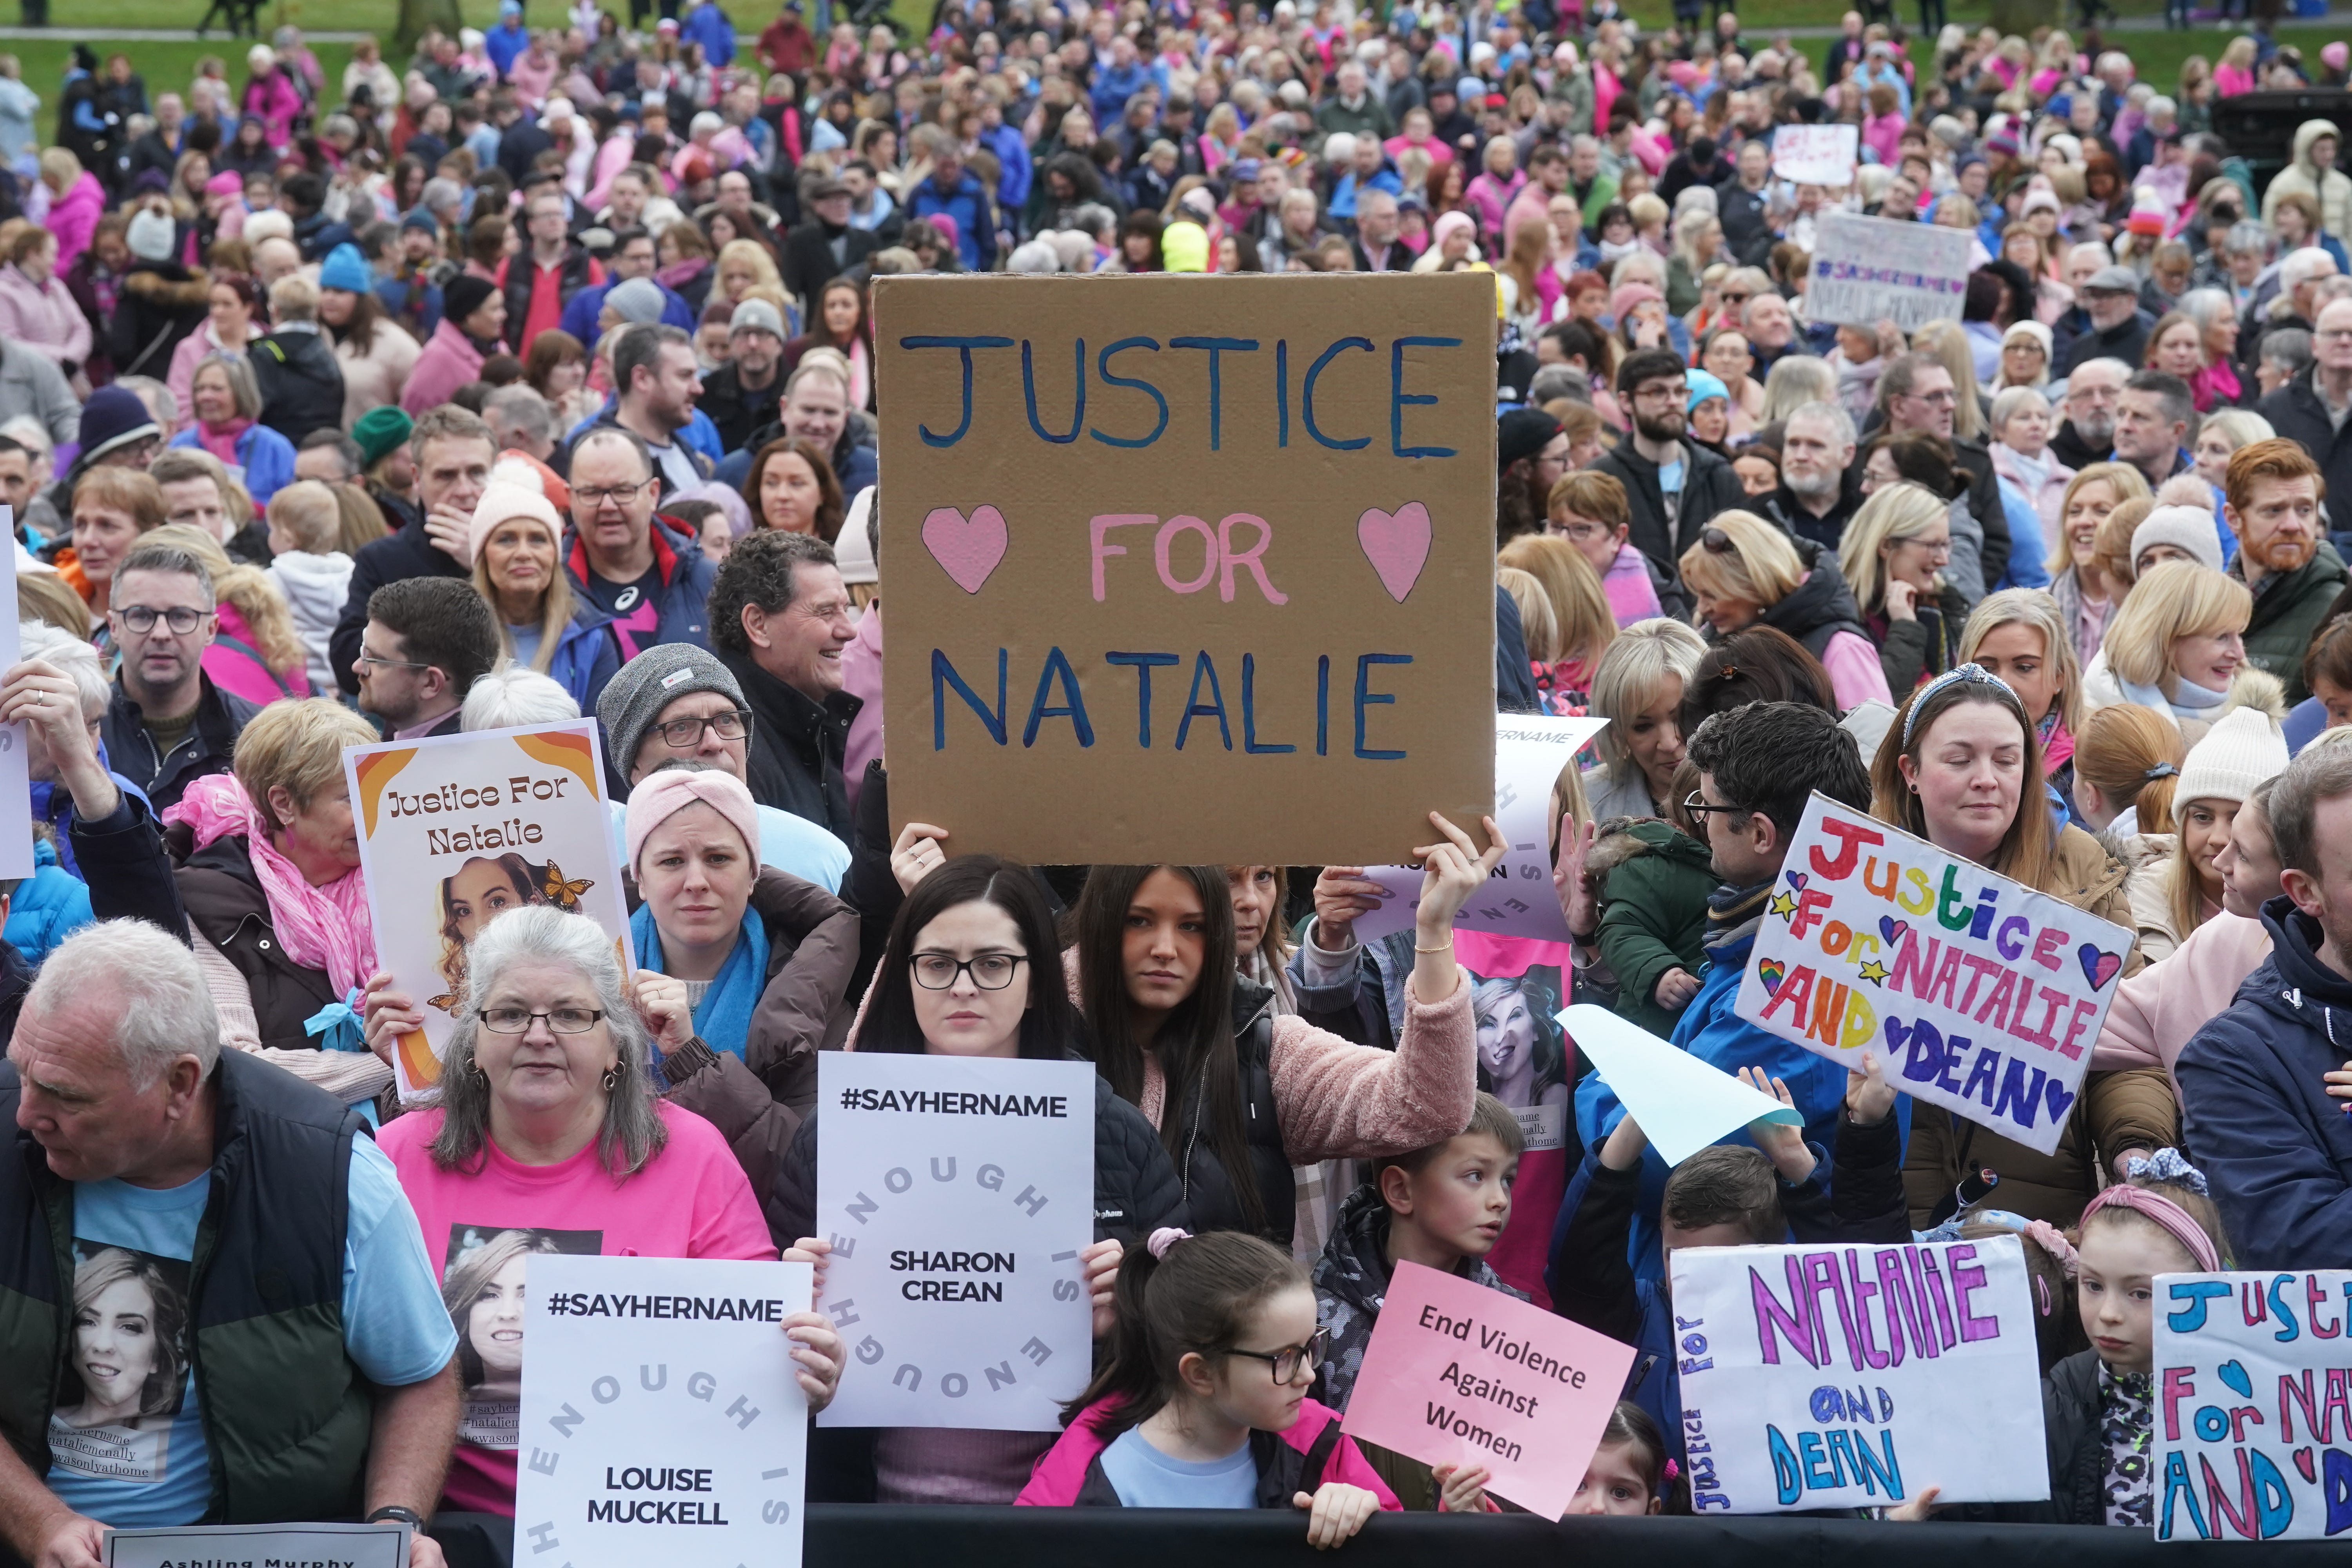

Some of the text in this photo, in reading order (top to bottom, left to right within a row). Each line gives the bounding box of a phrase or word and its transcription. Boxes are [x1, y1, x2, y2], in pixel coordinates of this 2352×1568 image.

[900, 336, 1463, 458] JUSTICE
[1089, 513, 1289, 606] FOR
[932, 646, 1413, 760] NATALIE
[1497, 730, 1574, 743] ERNAME
[388, 776, 568, 818] Justice For
[427, 818, 543, 855] Natalie
[1887, 927, 2097, 1061] NATALIE
[1760, 964, 2047, 1128] AND DEAN
[841, 1088, 1067, 1118] #SAYHERNAME
[831, 1157, 1049, 1259] ENOUGH
[890, 1250, 1014, 1273] SHARON
[902, 1281, 1002, 1302] CREAN
[548, 1293, 783, 1322] #SAYHERNAME
[1419, 1305, 1586, 1390] End Violence
[470, 1404, 518, 1415] #sayher
[528, 1364, 761, 1477] ENOUGH
[1439, 1362, 1539, 1419] Against
[2278, 1368, 2352, 1445] NA
[1426, 1401, 1522, 1463] Women
[606, 1466, 713, 1491] LOUISE
[1767, 1423, 1905, 1505] DEAN
[2159, 1447, 2294, 1541] AND
[587, 1500, 728, 1525] MUCKELL
